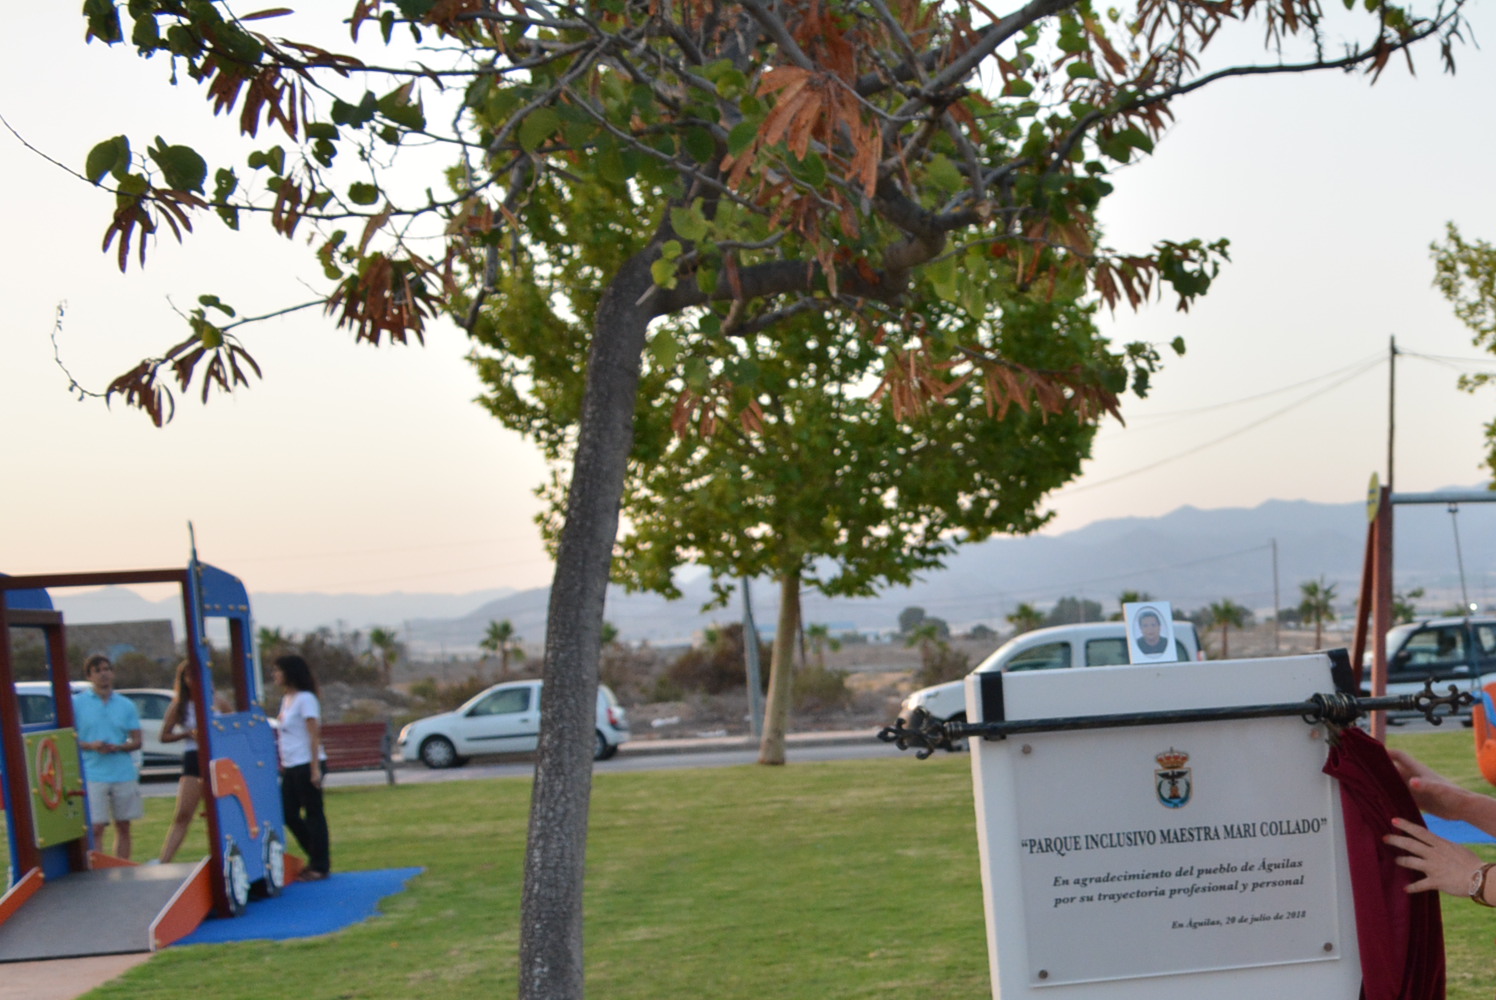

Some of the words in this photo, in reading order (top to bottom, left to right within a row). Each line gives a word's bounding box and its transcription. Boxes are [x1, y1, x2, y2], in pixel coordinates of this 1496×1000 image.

[1085, 829, 1156, 850] INCLUSIVO
[1160, 825, 1221, 844] MAESTRA
[1223, 822, 1257, 840] MARI
[1053, 876, 1069, 886] En
[1073, 869, 1172, 887] agradecimiento
[1175, 866, 1194, 877] del
[1197, 863, 1237, 878] pueblo
[1240, 862, 1255, 872] de
[1257, 857, 1303, 873] Águilas
[1053, 896, 1076, 907] por
[1097, 886, 1166, 903] trayectoria
[1169, 880, 1239, 899] profesional
[1240, 883, 1249, 893] y
[1251, 875, 1304, 892] personal
[1171, 920, 1184, 929] En
[1238, 914, 1249, 923] de
[1250, 911, 1272, 925] julio
[1274, 911, 1284, 920] de
